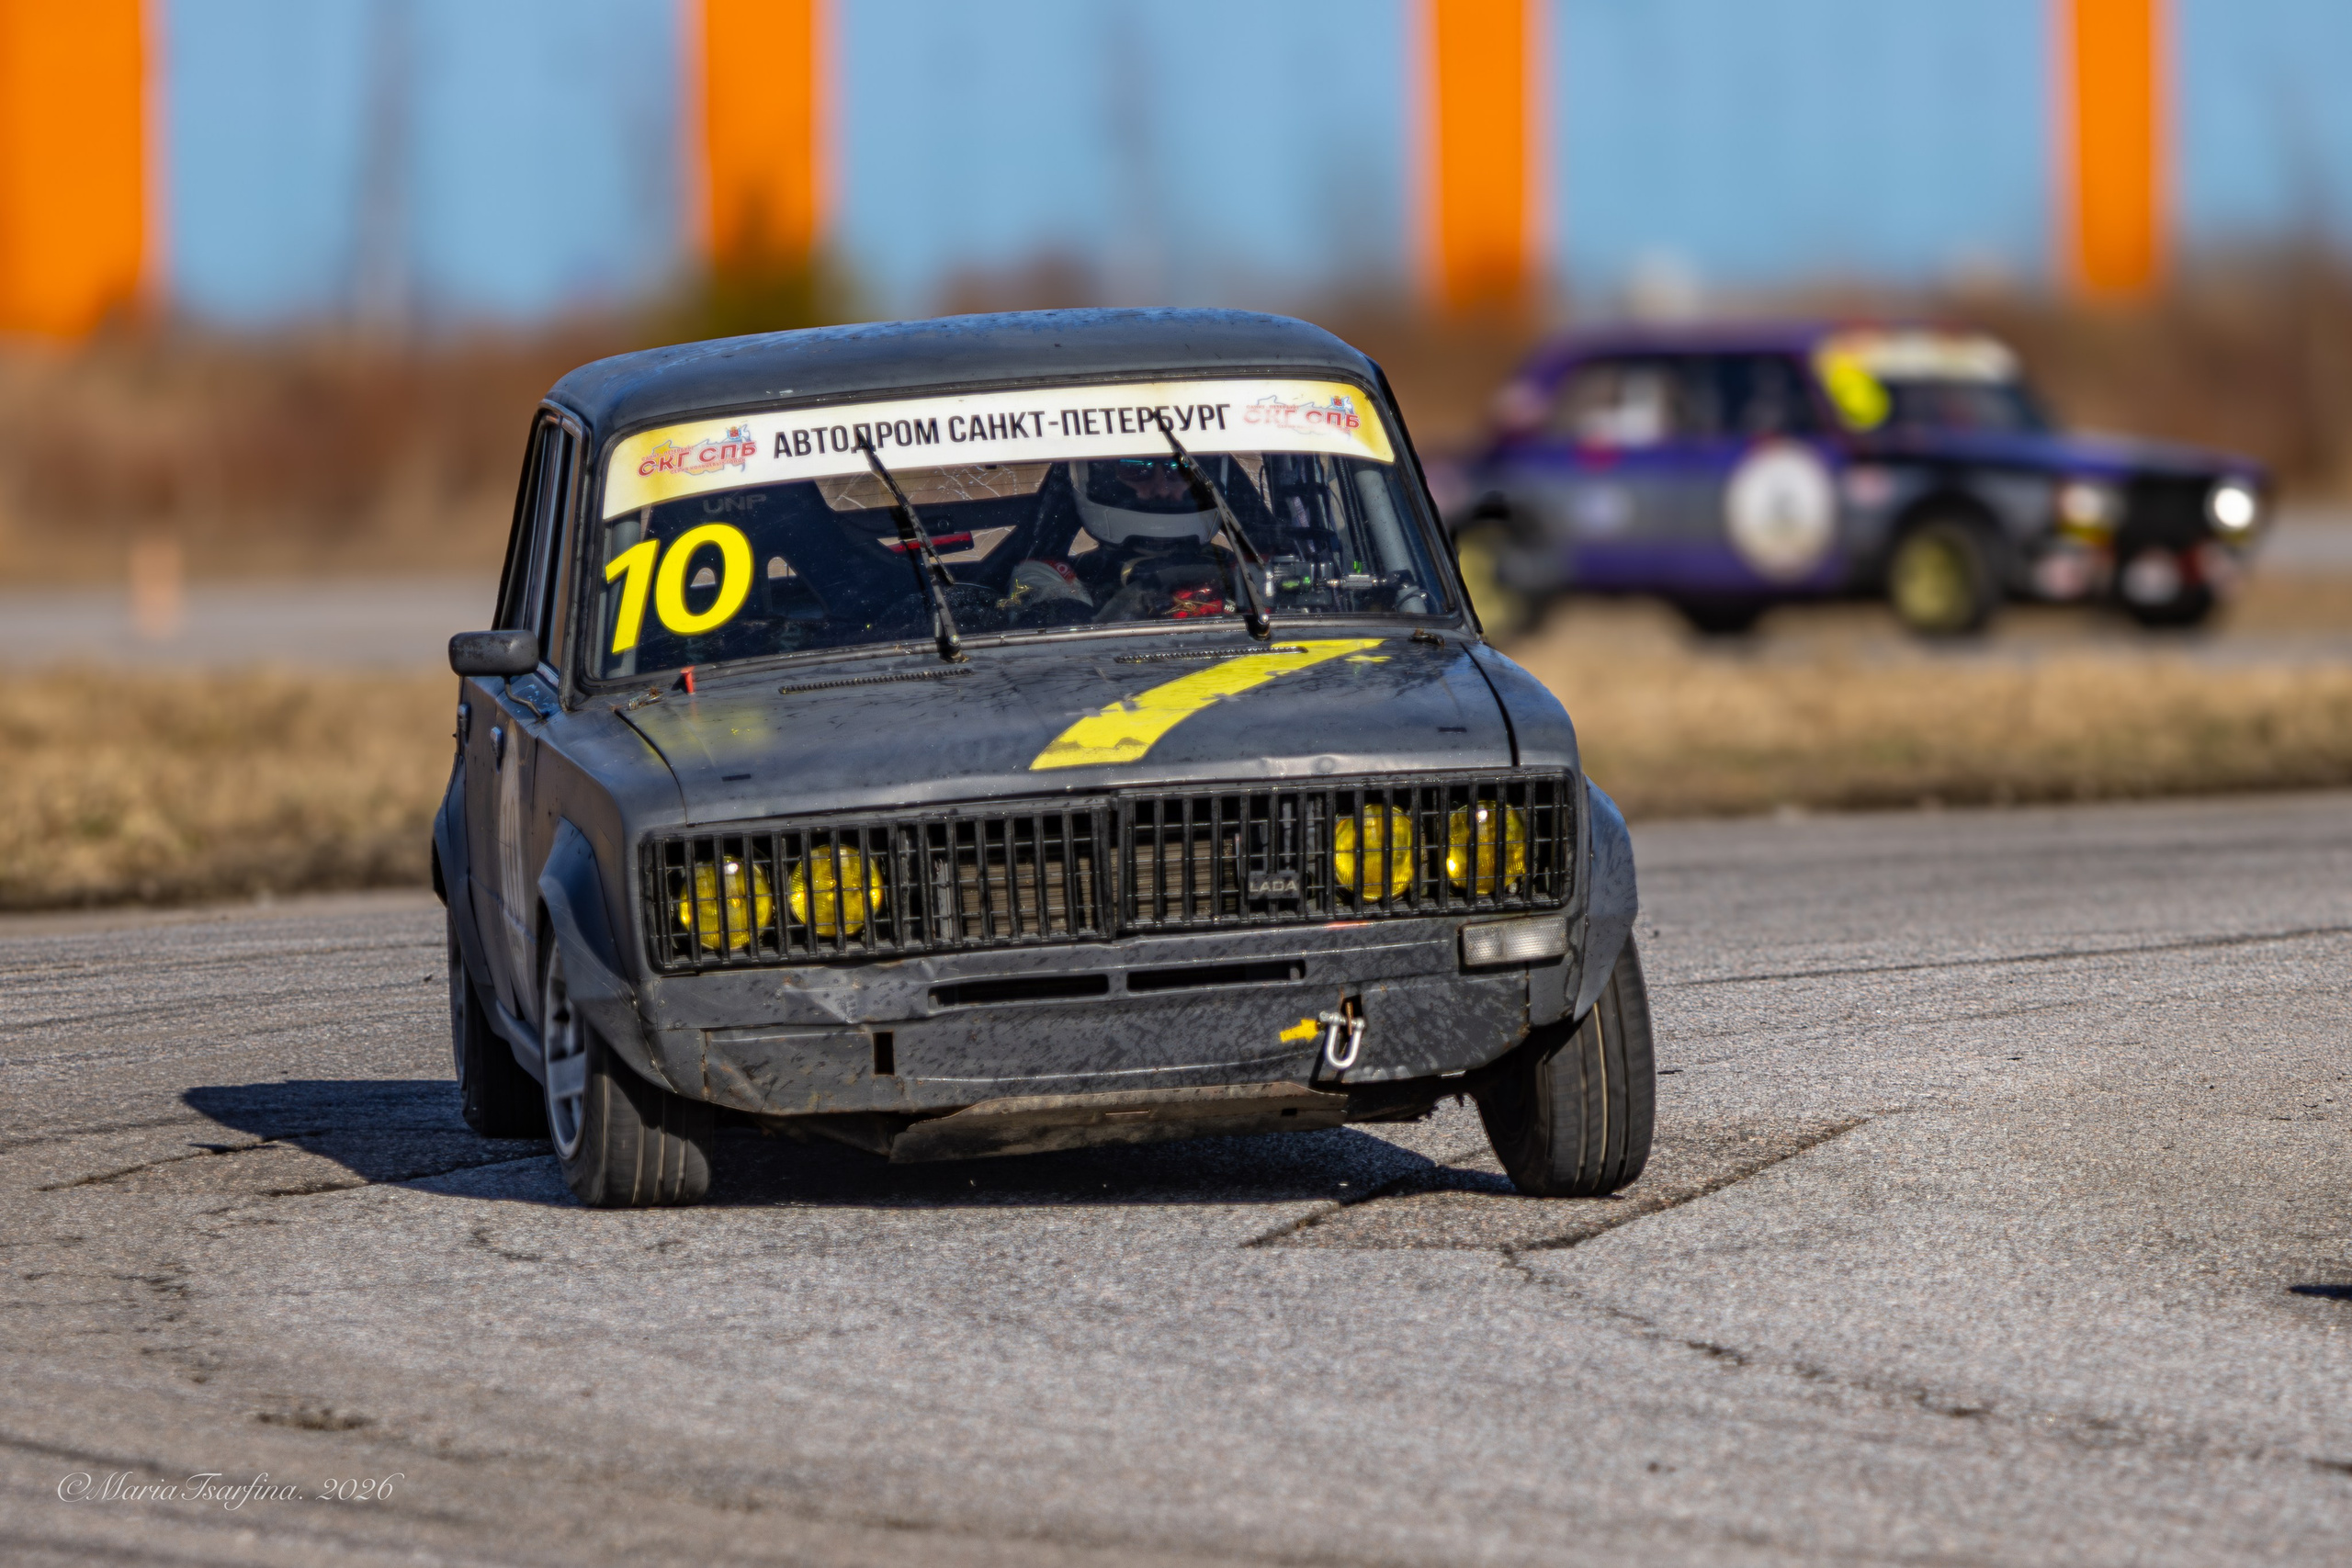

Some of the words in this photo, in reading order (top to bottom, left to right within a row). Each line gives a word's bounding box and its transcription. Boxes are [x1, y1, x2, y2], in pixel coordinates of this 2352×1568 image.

[774, 417, 940, 459] АВТОДРОМ
[947, 403, 1231, 444] САНКТ-ПЕТЕРБУРГ
[638, 451, 690, 477] СКГ
[698, 440, 757, 463] СПБ
[605, 523, 754, 655] 10
[1250, 880, 1298, 893] LADA
